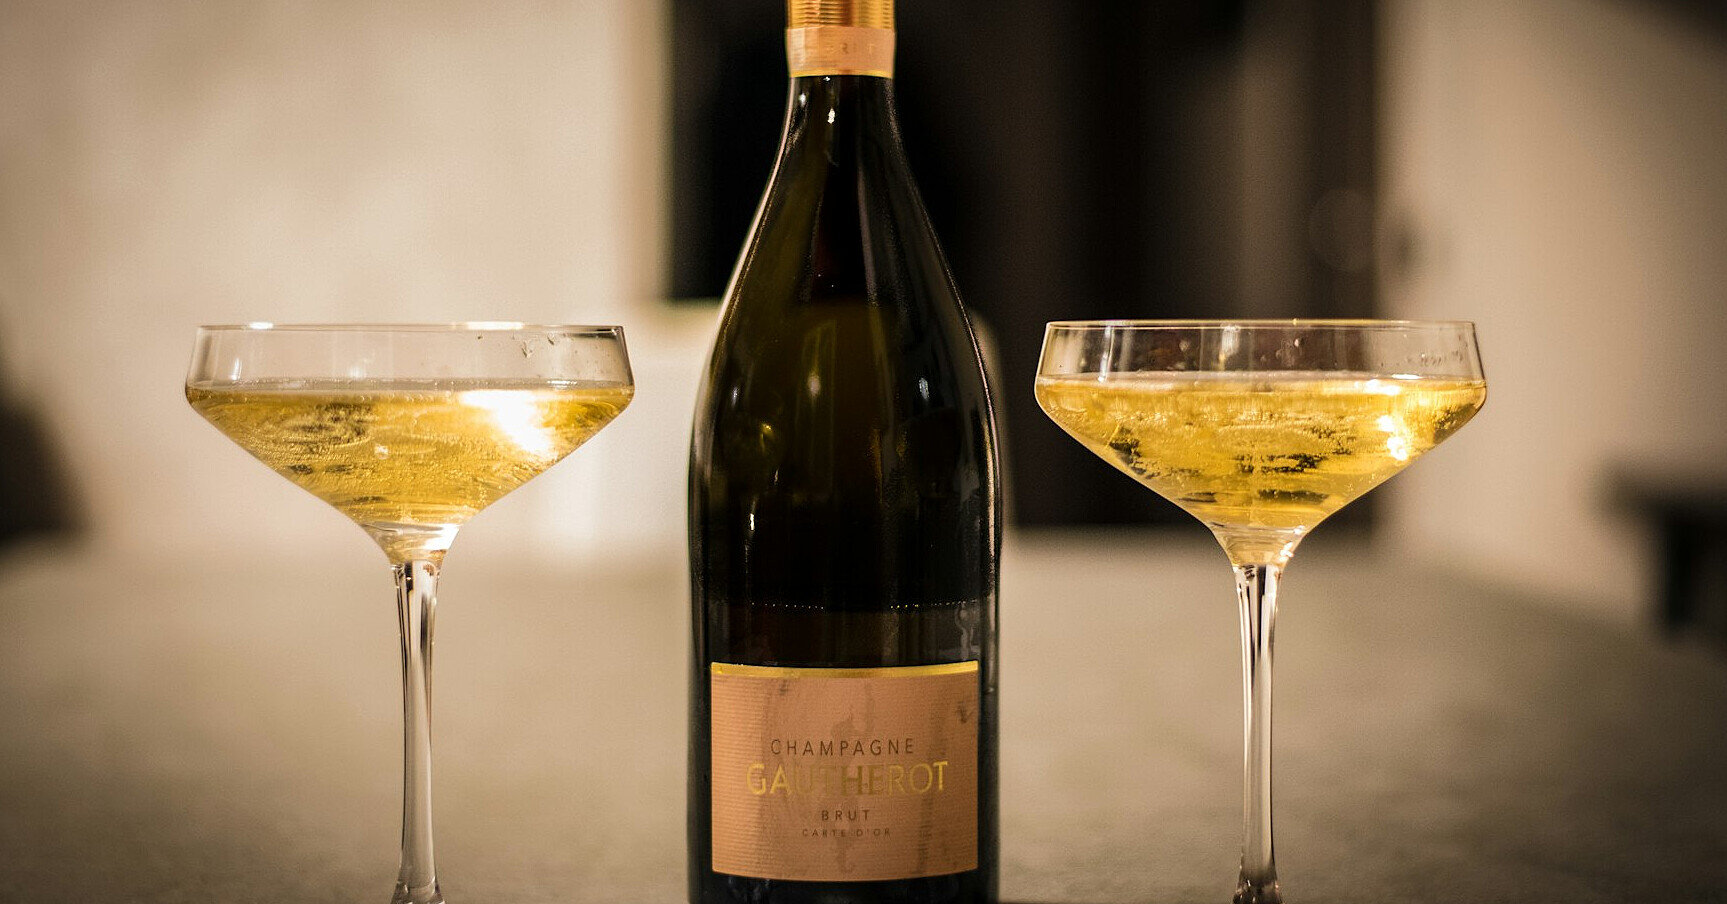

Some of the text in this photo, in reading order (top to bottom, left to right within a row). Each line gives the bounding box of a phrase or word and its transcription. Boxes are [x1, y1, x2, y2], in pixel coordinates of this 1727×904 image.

[771, 738, 914, 756] CHAMPAGNE
[746, 760, 949, 797] GAUTHEROT
[821, 809, 871, 821] BRUT
[802, 827, 891, 838] CARTE D'OR
